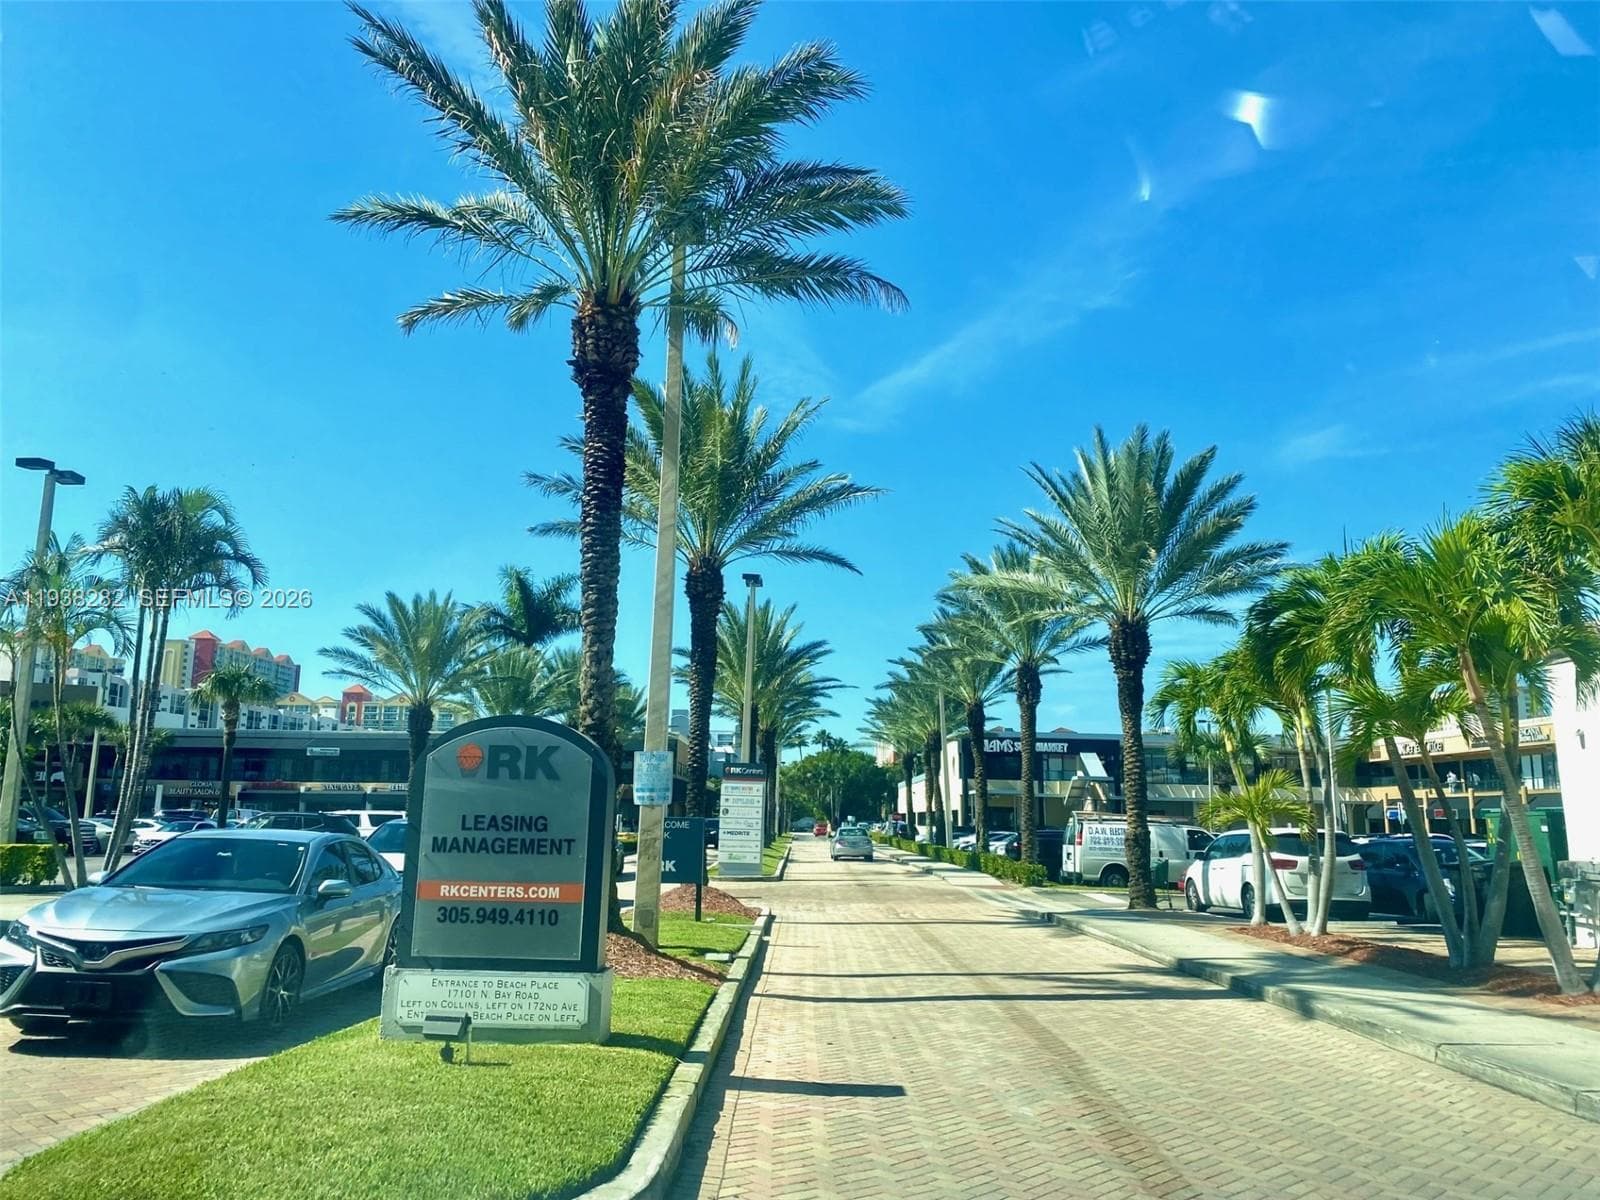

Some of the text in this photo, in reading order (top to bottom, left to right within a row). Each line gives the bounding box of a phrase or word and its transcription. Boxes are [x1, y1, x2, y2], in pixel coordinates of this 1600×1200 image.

[486, 744, 562, 781] RK
[461, 814, 549, 833] LEASING
[664, 820, 691, 829] COME
[431, 836, 576, 856] MANAGEMENT
[440, 884, 560, 899] RKCENTERS.COM
[436, 906, 559, 927] 305.949.4110
[431, 978, 559, 990] ENTRANCE TO BEACH PLACE
[448, 989, 476, 999] 17101
[494, 990, 512, 1000] BAY
[400, 1000, 422, 1008] LEFT
[425, 1000, 438, 1009] ON
[486, 1002, 507, 1010] LEFT
[510, 1002, 523, 1010] ON
[528, 1001, 558, 1011] 172ND
[472, 1011, 502, 1021] BEACH
[505, 1011, 535, 1022] PLACE
[537, 1014, 550, 1022] ON
